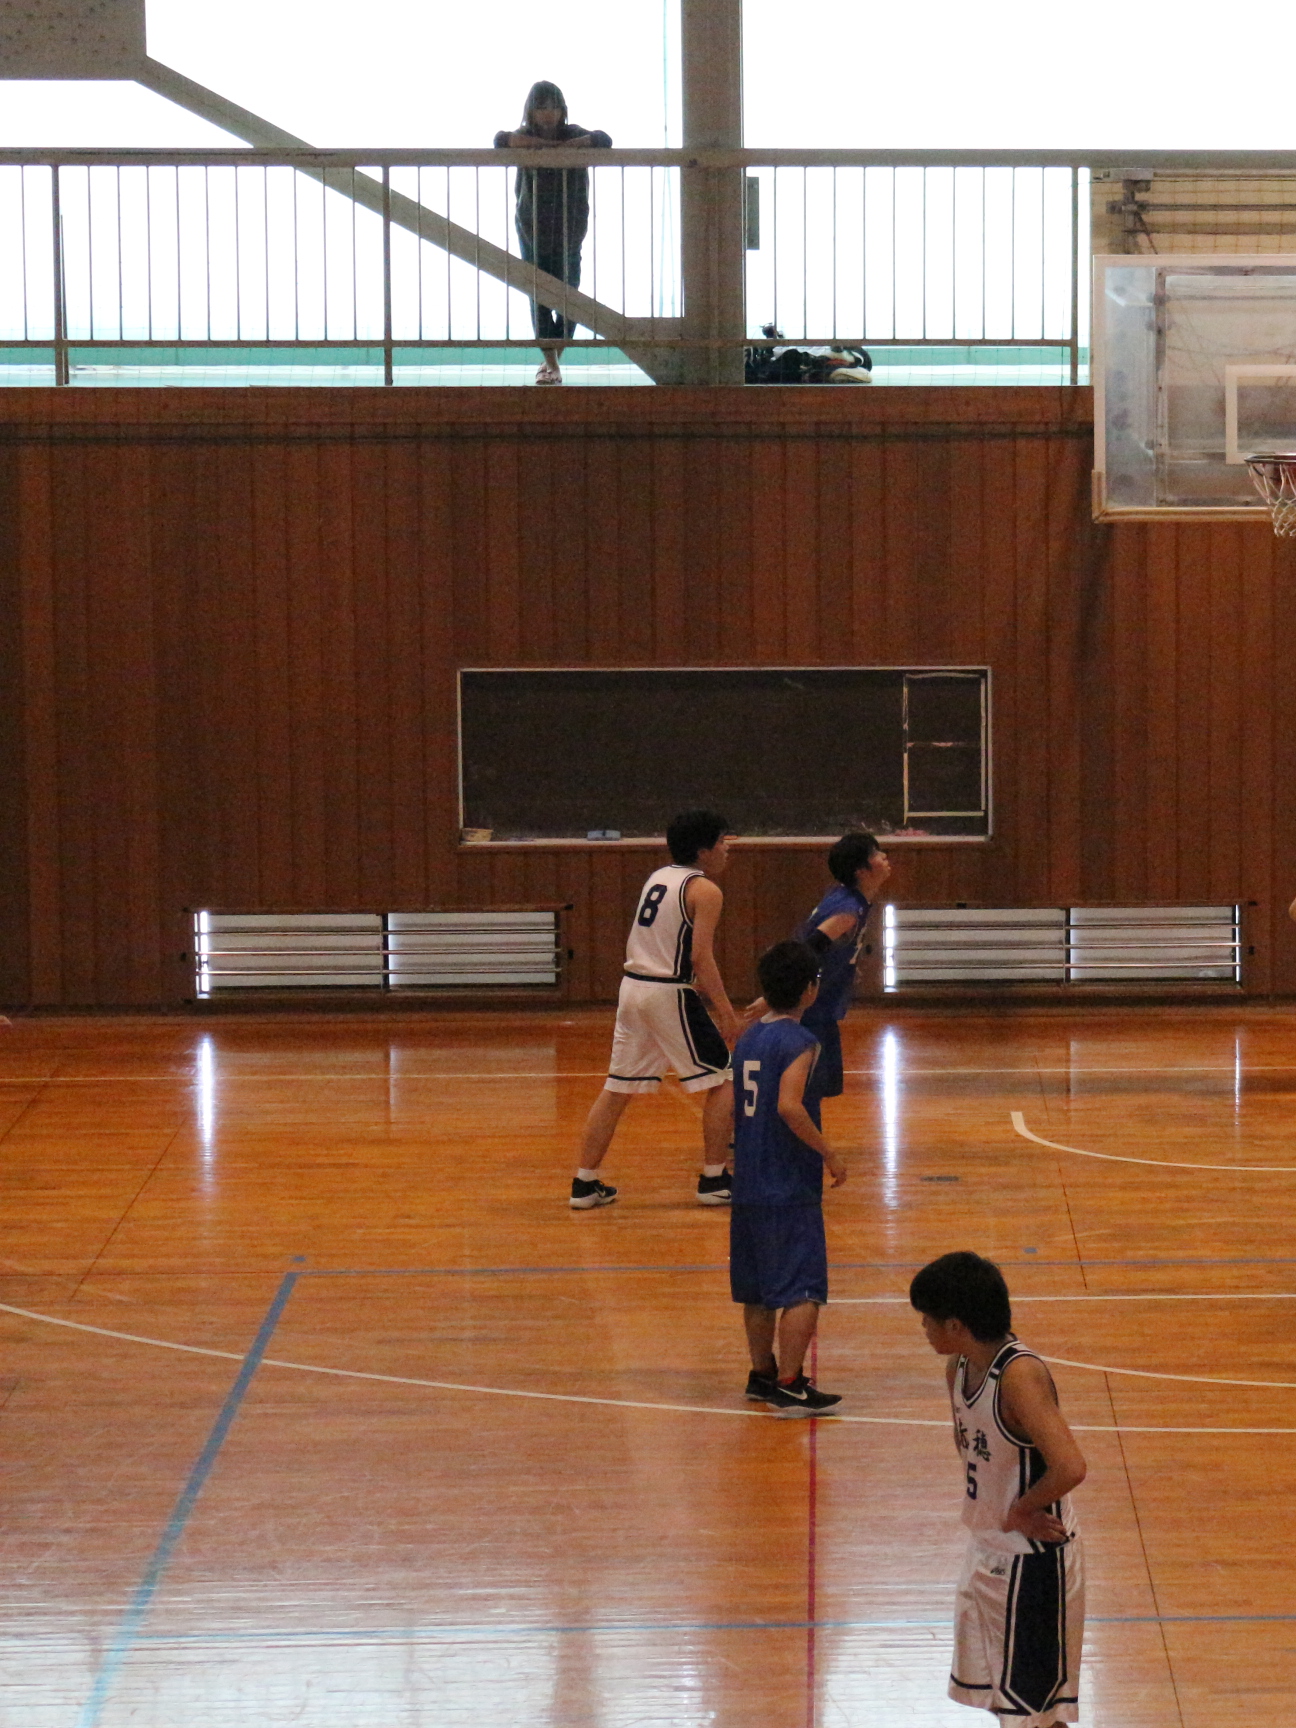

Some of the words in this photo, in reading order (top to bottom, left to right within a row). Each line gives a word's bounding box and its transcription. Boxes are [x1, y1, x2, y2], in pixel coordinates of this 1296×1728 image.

[638, 884, 668, 927] 8
[743, 1060, 761, 1117] 5
[966, 1461, 978, 1500] 5
